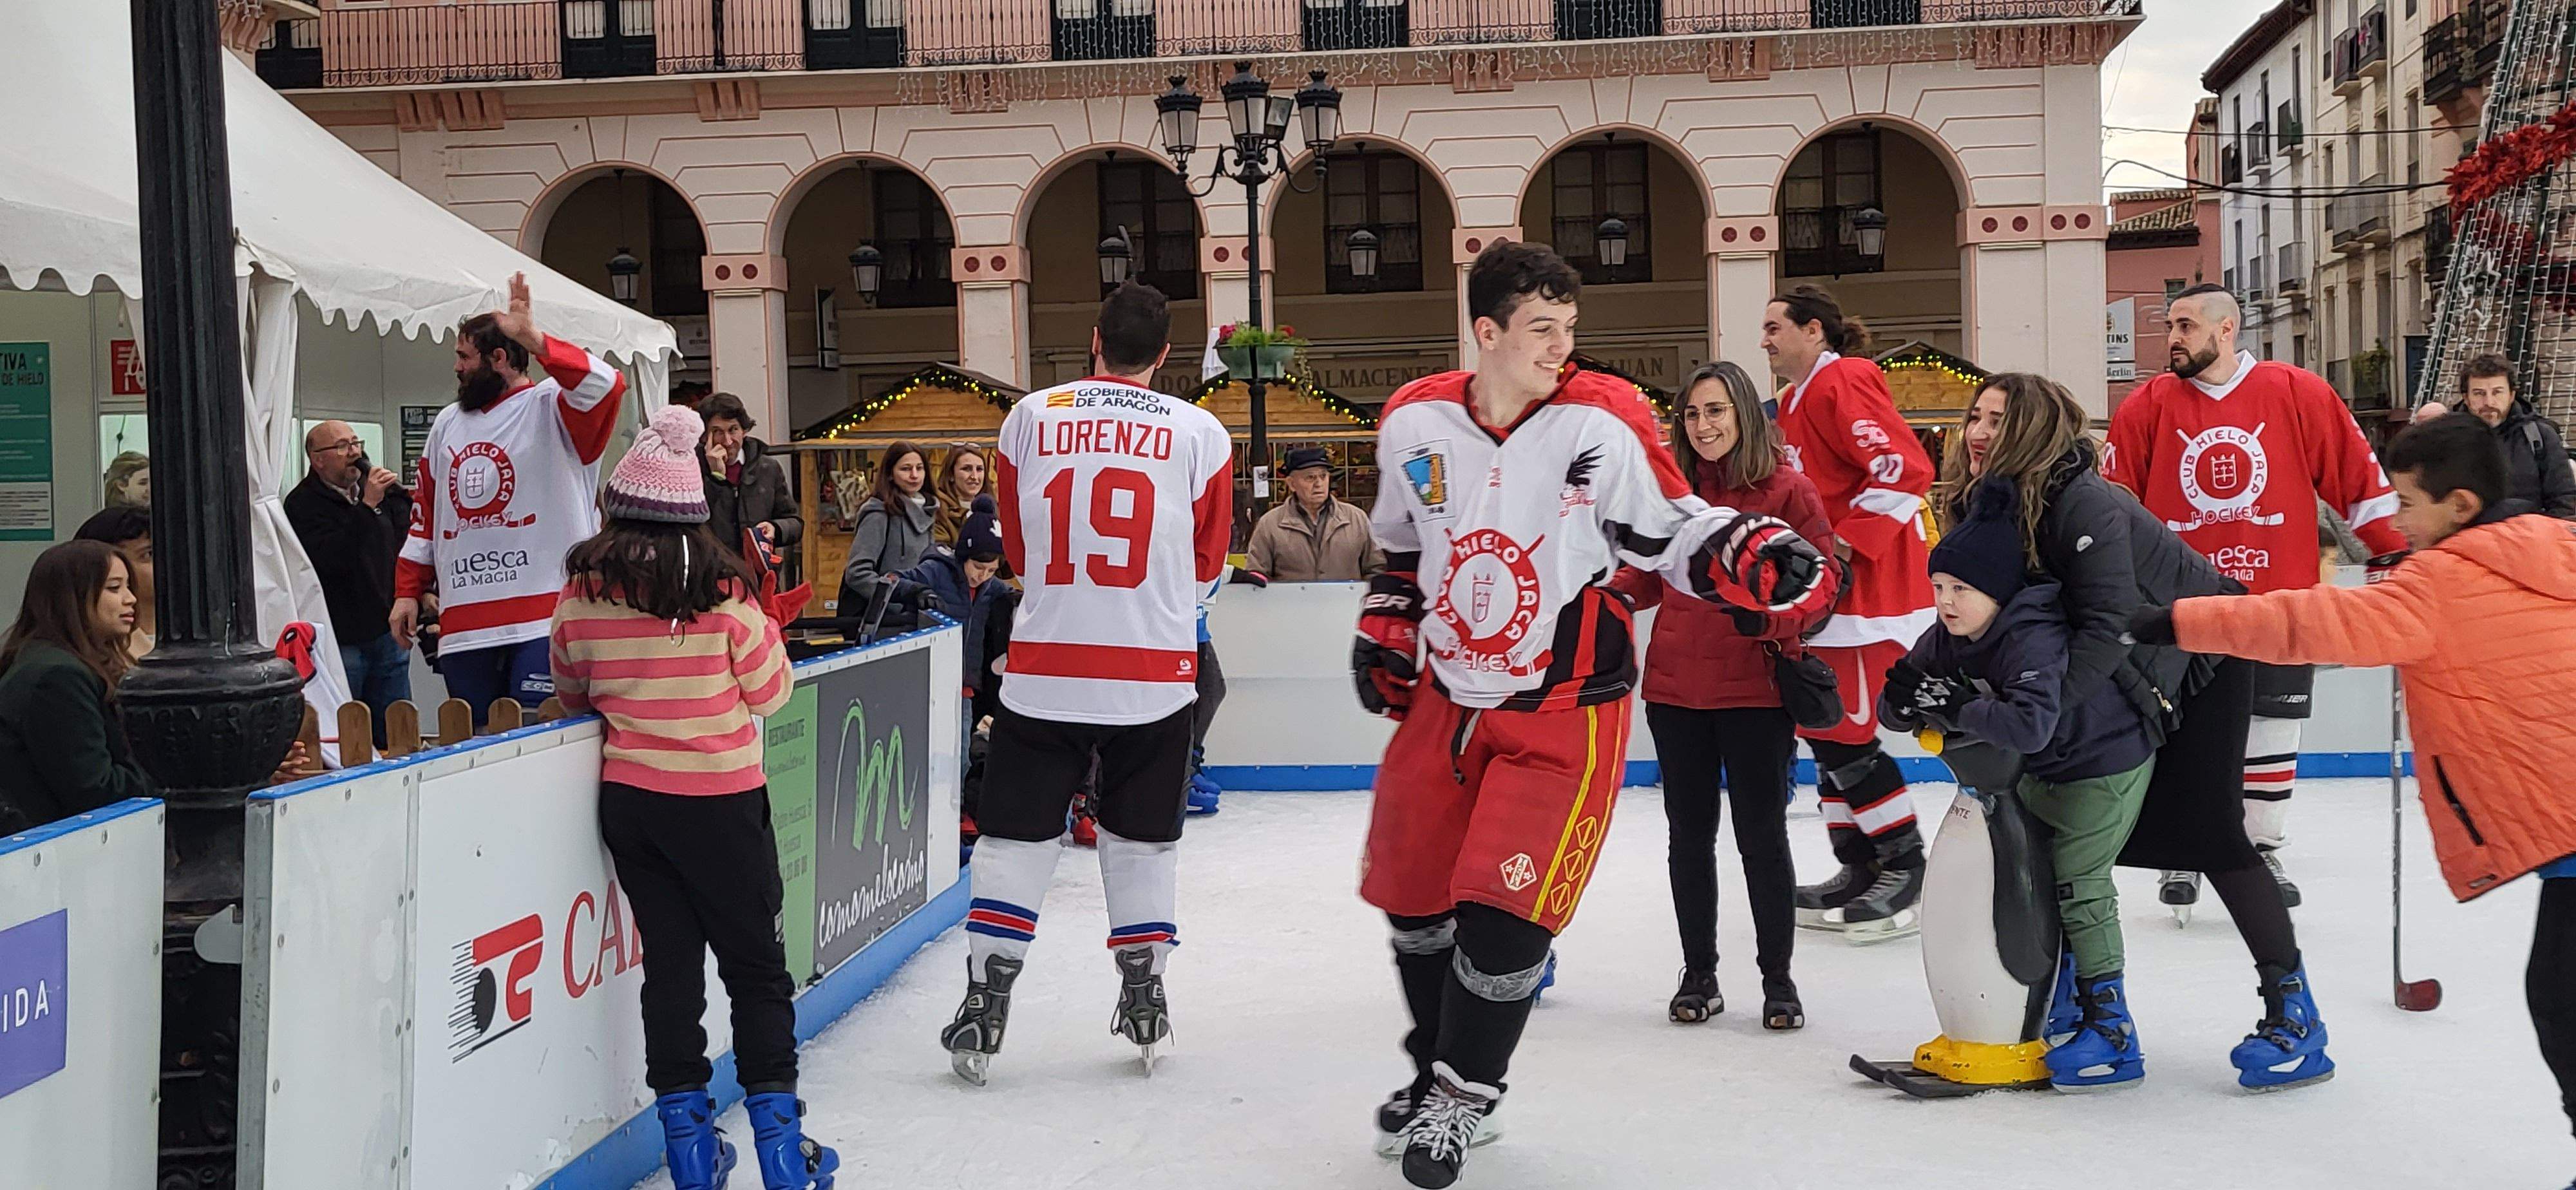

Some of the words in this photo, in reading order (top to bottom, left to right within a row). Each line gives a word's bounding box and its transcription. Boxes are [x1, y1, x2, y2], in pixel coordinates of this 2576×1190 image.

[17, 372, 44, 386] HIELO
[1312, 365, 1446, 388] ALMACENE
[1075, 397, 1096, 408] DE
[1101, 397, 1171, 416] ARAGON
[1077, 388, 1160, 403] GOBIERNO
[1037, 419, 1173, 461] LORENZO
[2183, 454, 2199, 500] CLUB
[2196, 430, 2249, 449] HIELO
[2250, 451, 2265, 495] JACA
[1043, 466, 1155, 589] 19
[2190, 505, 2262, 526] HOCKEY
[451, 549, 529, 576] uesca
[1455, 533, 1520, 563] HIELO
[1504, 576, 1538, 640] JACA
[3, 979, 50, 1033] IDA
